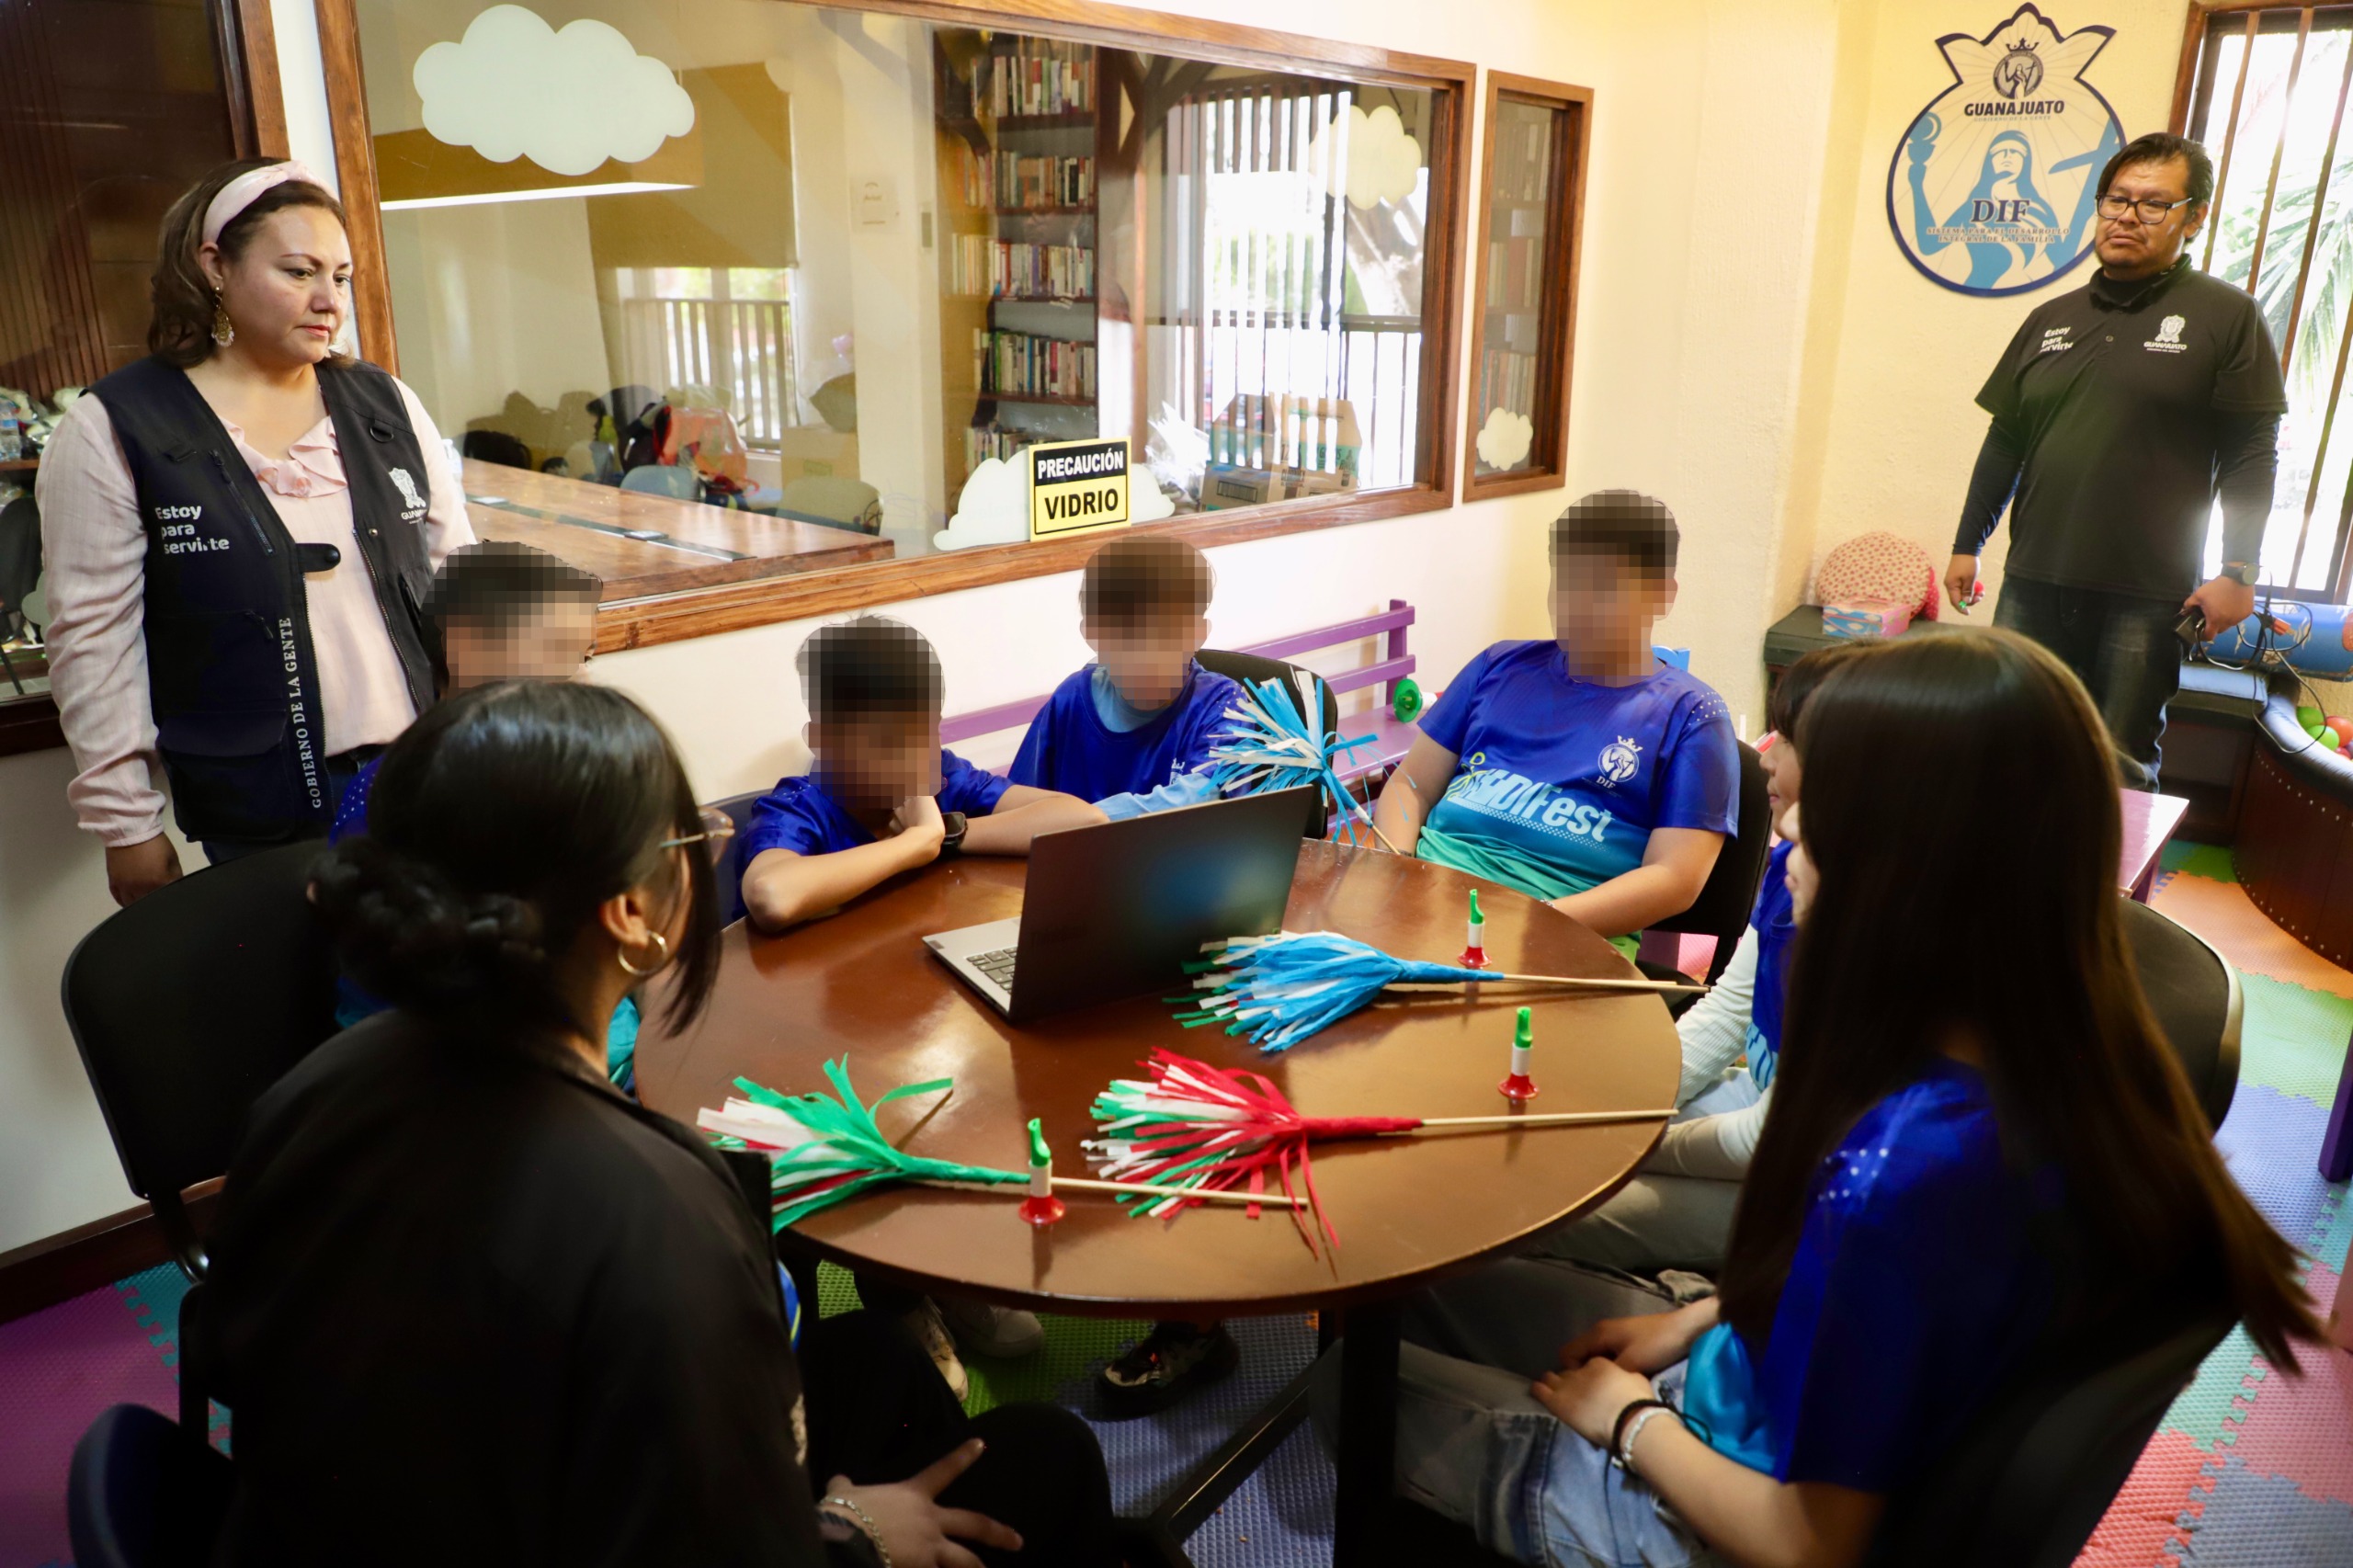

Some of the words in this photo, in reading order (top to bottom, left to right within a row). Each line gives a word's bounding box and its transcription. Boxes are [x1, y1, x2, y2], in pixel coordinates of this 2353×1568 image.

[1963, 100, 2065, 117] GUANAJUATO
[1970, 199, 2030, 223] DIF
[1927, 227, 1966, 235] SISTEMA
[1968, 227, 1993, 235] PARA
[1994, 227, 2005, 235] EL
[2008, 227, 2070, 235] DESARROLLO
[2015, 235, 2055, 244] FAMILIA
[2044, 326, 2072, 338] Estoy
[2040, 335, 2063, 348] para
[1037, 447, 1124, 480] PRECAUCIÓN
[1044, 487, 1119, 520] VIDRIO
[154, 505, 202, 520] Estoy
[161, 523, 196, 540] para
[278, 617, 298, 672] GENTE
[288, 676, 301, 699] LA
[290, 701, 306, 724] DE
[296, 728, 322, 809] GOBIERNO
[1595, 775, 1617, 790] DIF
